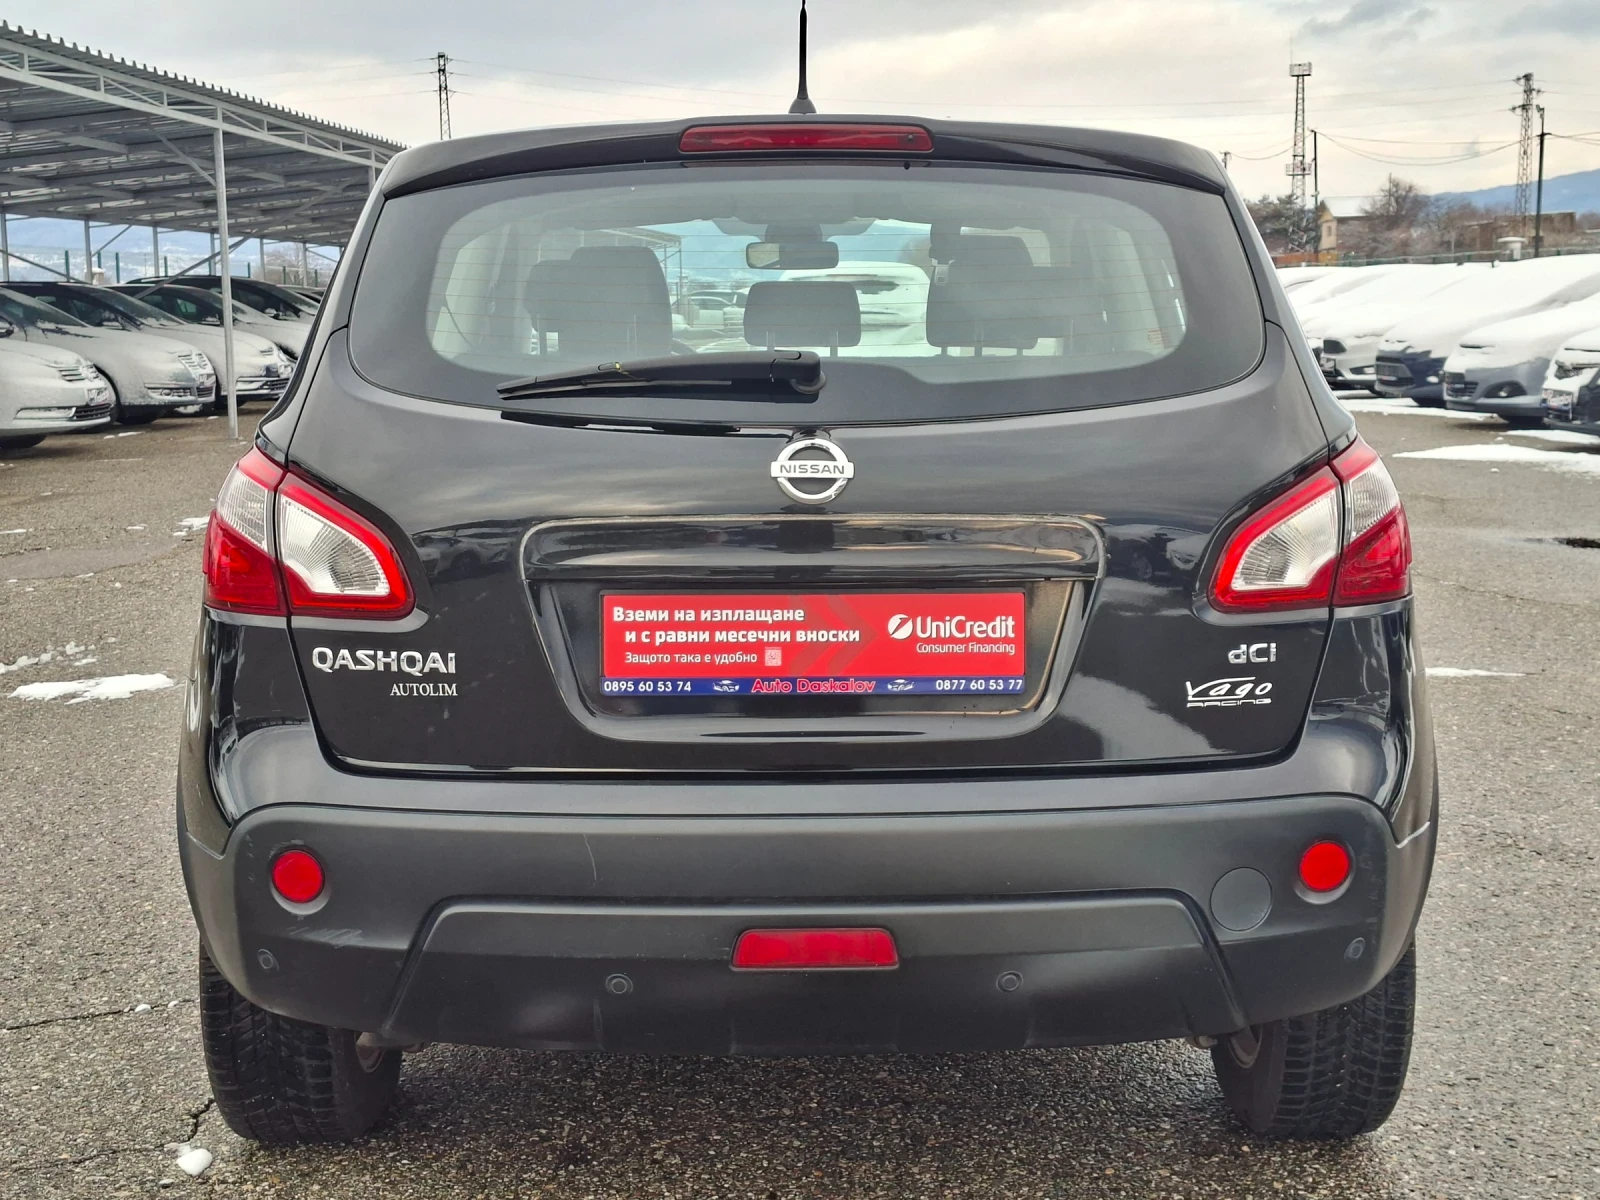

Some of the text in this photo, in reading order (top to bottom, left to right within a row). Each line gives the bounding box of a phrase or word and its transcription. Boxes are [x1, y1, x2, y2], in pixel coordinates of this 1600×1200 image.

[780, 464, 844, 474] NISSAN
[613, 607, 805, 624] Вземи на изплащане
[916, 615, 1015, 638] UniCredit
[625, 630, 860, 646] и с равни месечни вноски
[916, 642, 1015, 655] Consumer Financing
[1228, 642, 1277, 664] dCi
[312, 646, 456, 676] QASHQAI
[625, 652, 758, 665] Защото така е удобно
[390, 683, 458, 696] AUTOLIM
[604, 681, 692, 692] 0895 60 53 74
[751, 678, 876, 693] Auto Daskalov
[936, 679, 1023, 691] 0877 60 53 77
